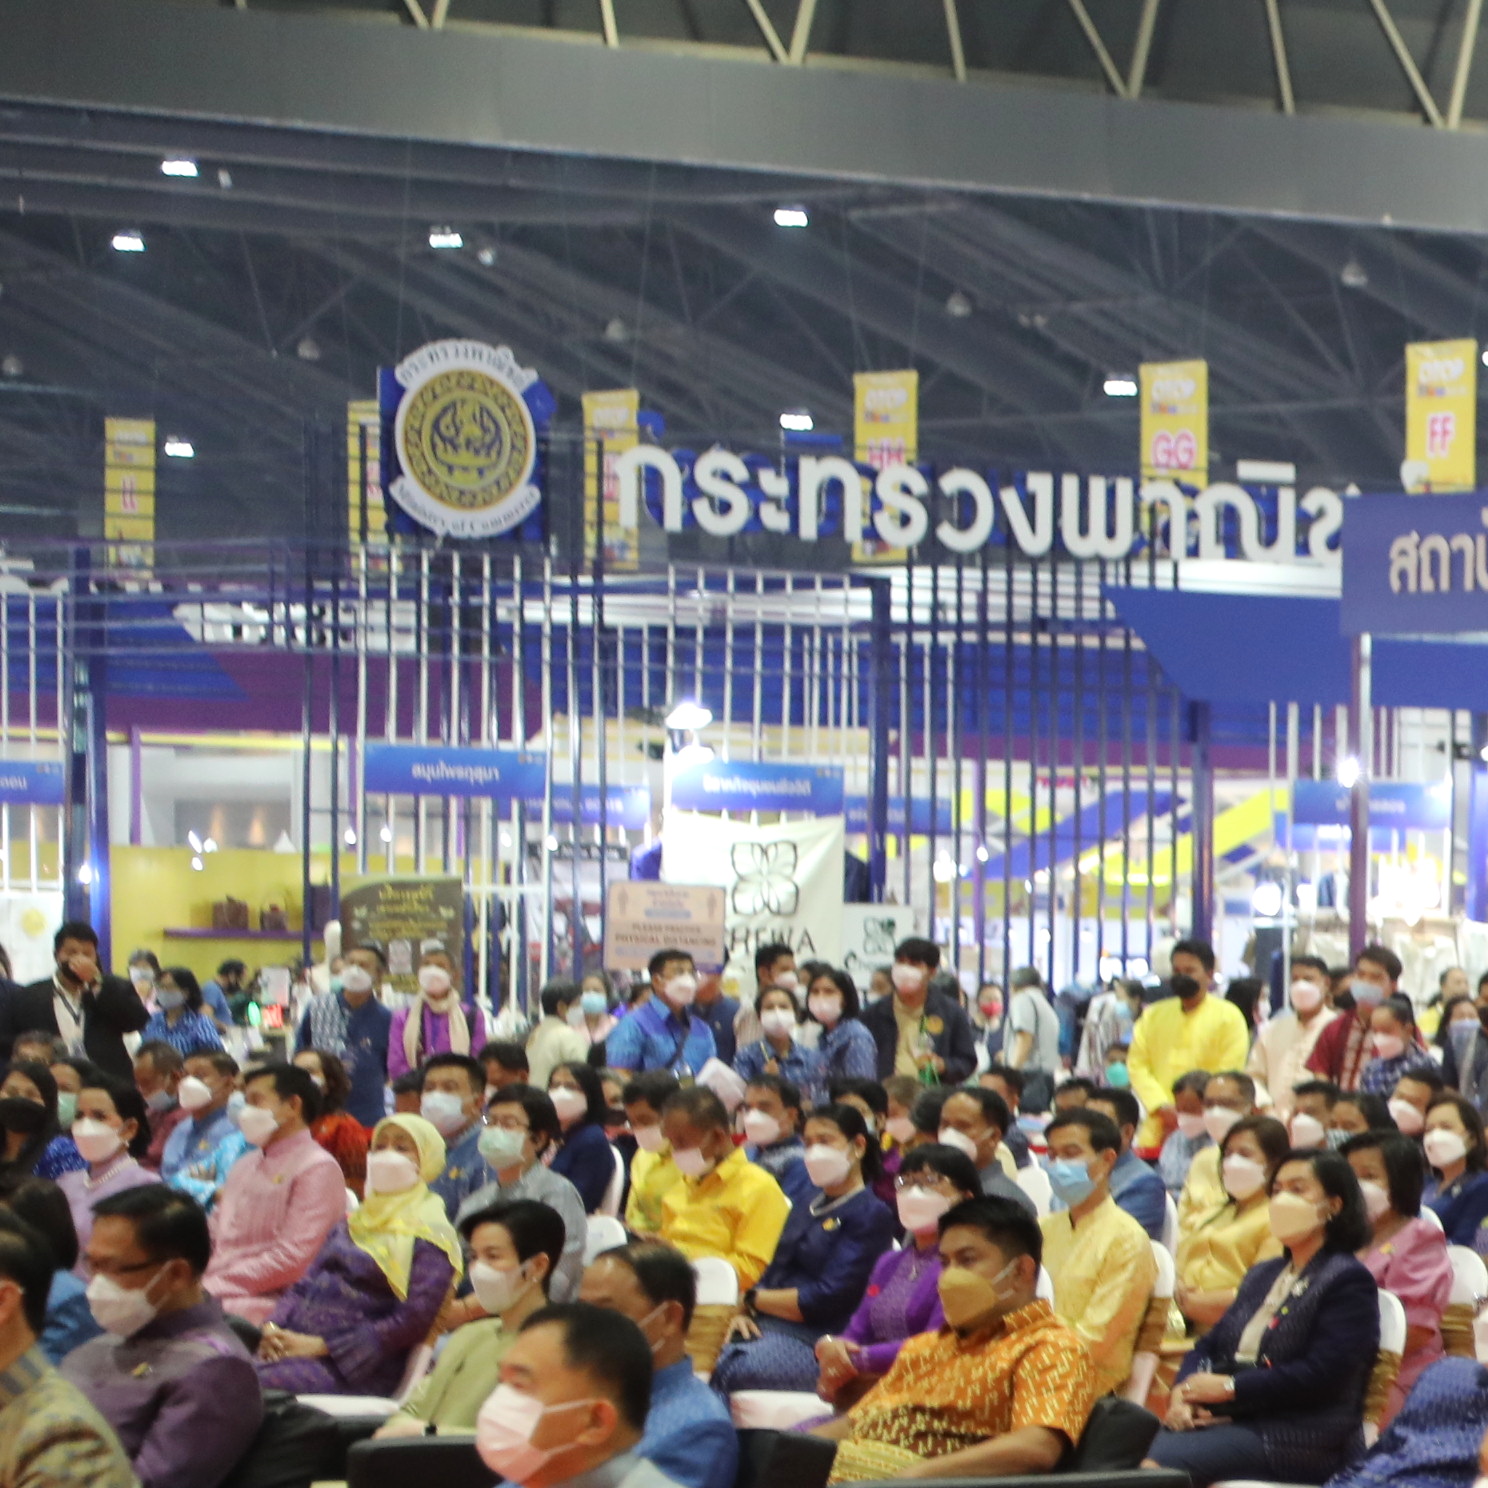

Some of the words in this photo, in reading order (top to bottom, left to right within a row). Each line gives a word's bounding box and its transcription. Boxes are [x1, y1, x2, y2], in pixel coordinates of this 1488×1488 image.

[1152, 429, 1196, 473] GG
[1428, 413, 1454, 456] FF
[614, 443, 1345, 566] กระทรวงพาณิช
[729, 924, 818, 955] HEWA
